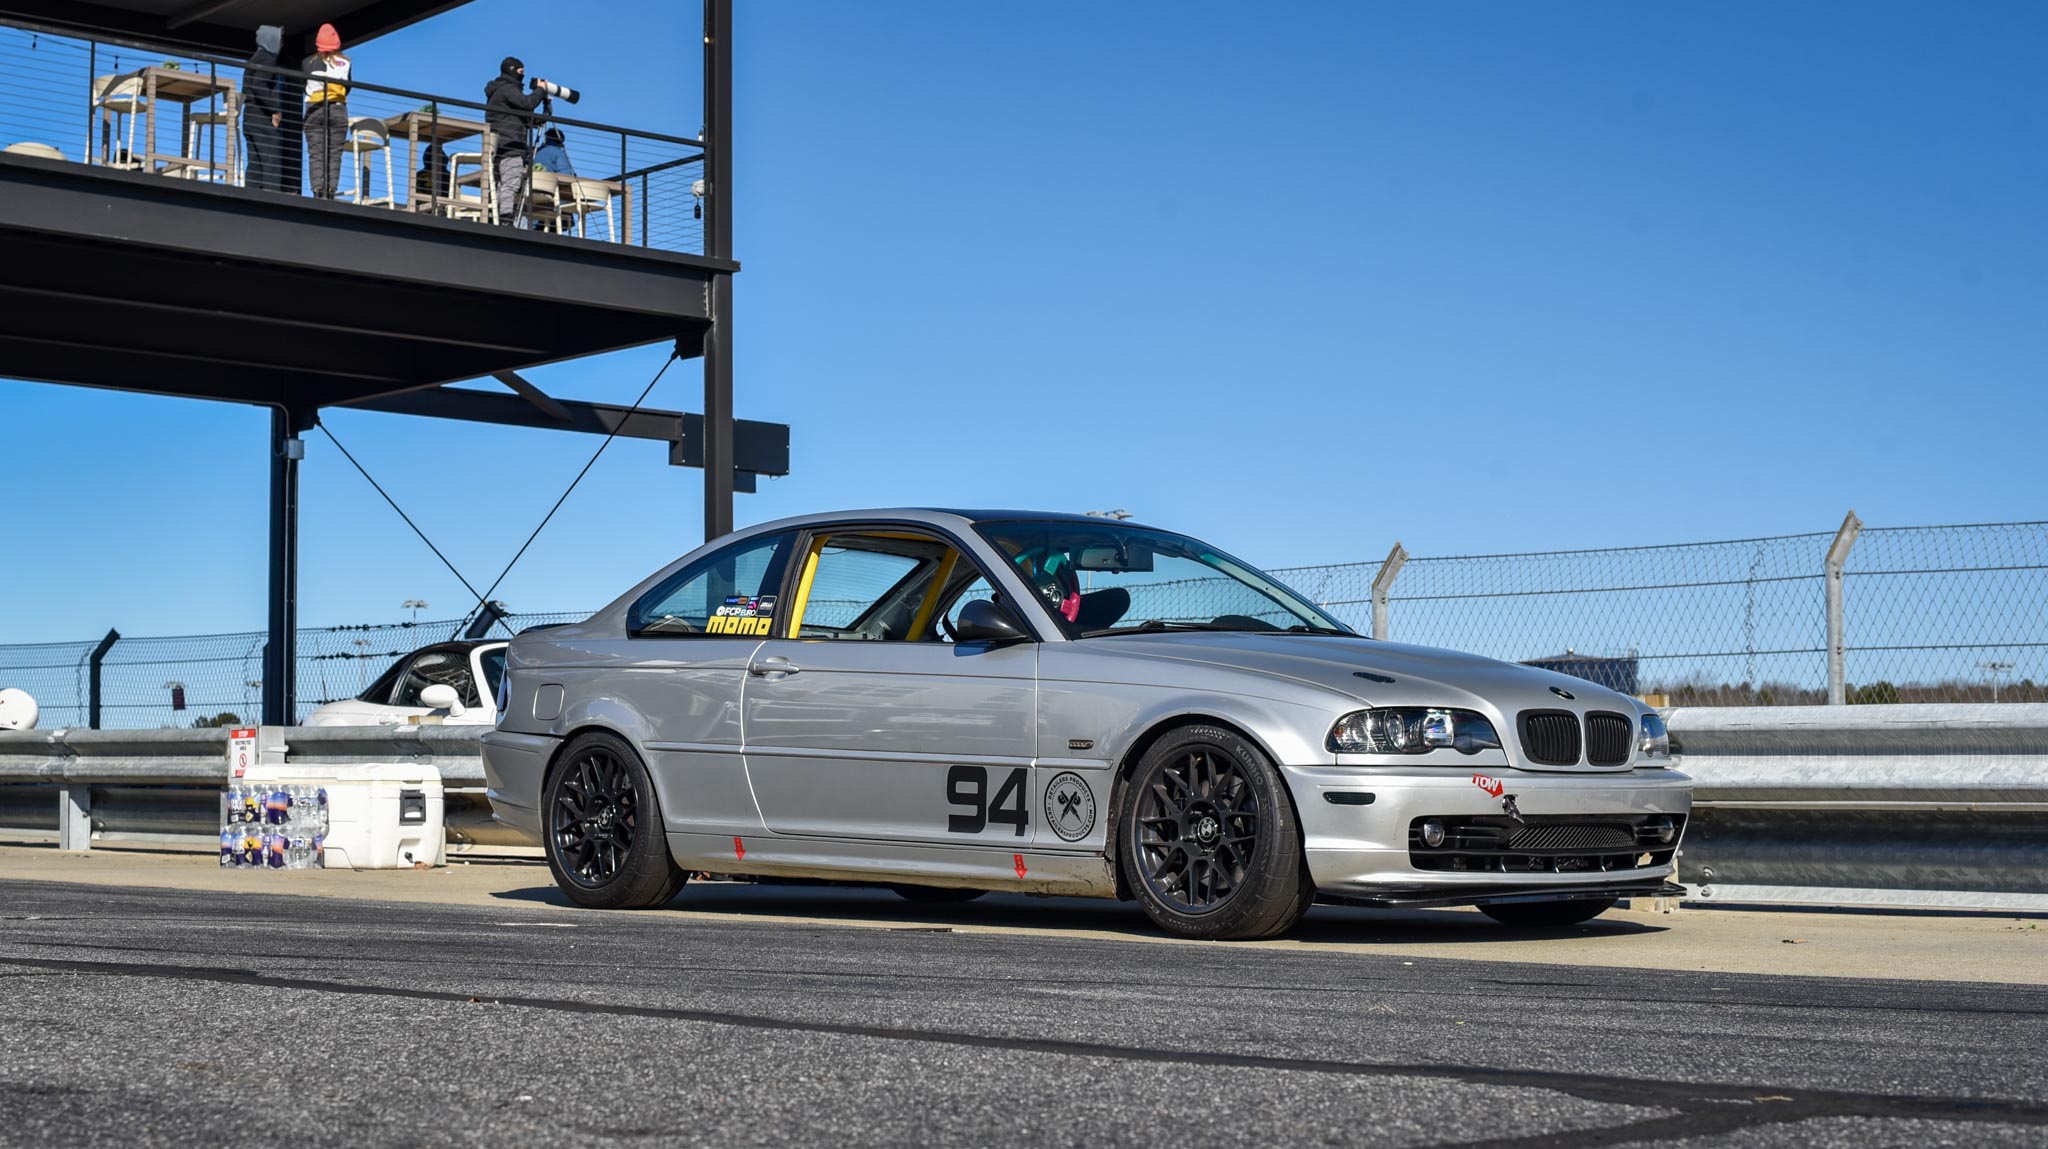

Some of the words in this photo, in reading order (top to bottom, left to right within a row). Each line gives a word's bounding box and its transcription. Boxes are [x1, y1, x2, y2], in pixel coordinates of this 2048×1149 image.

[724, 607, 742, 616] FCP
[740, 609, 756, 617] EURO
[1235, 745, 1263, 785] KUMHO
[1047, 776, 1069, 800] DETAILERS
[1069, 776, 1092, 802] PRODUCTS
[1473, 776, 1500, 792] TOW
[946, 765, 1029, 837] 94
